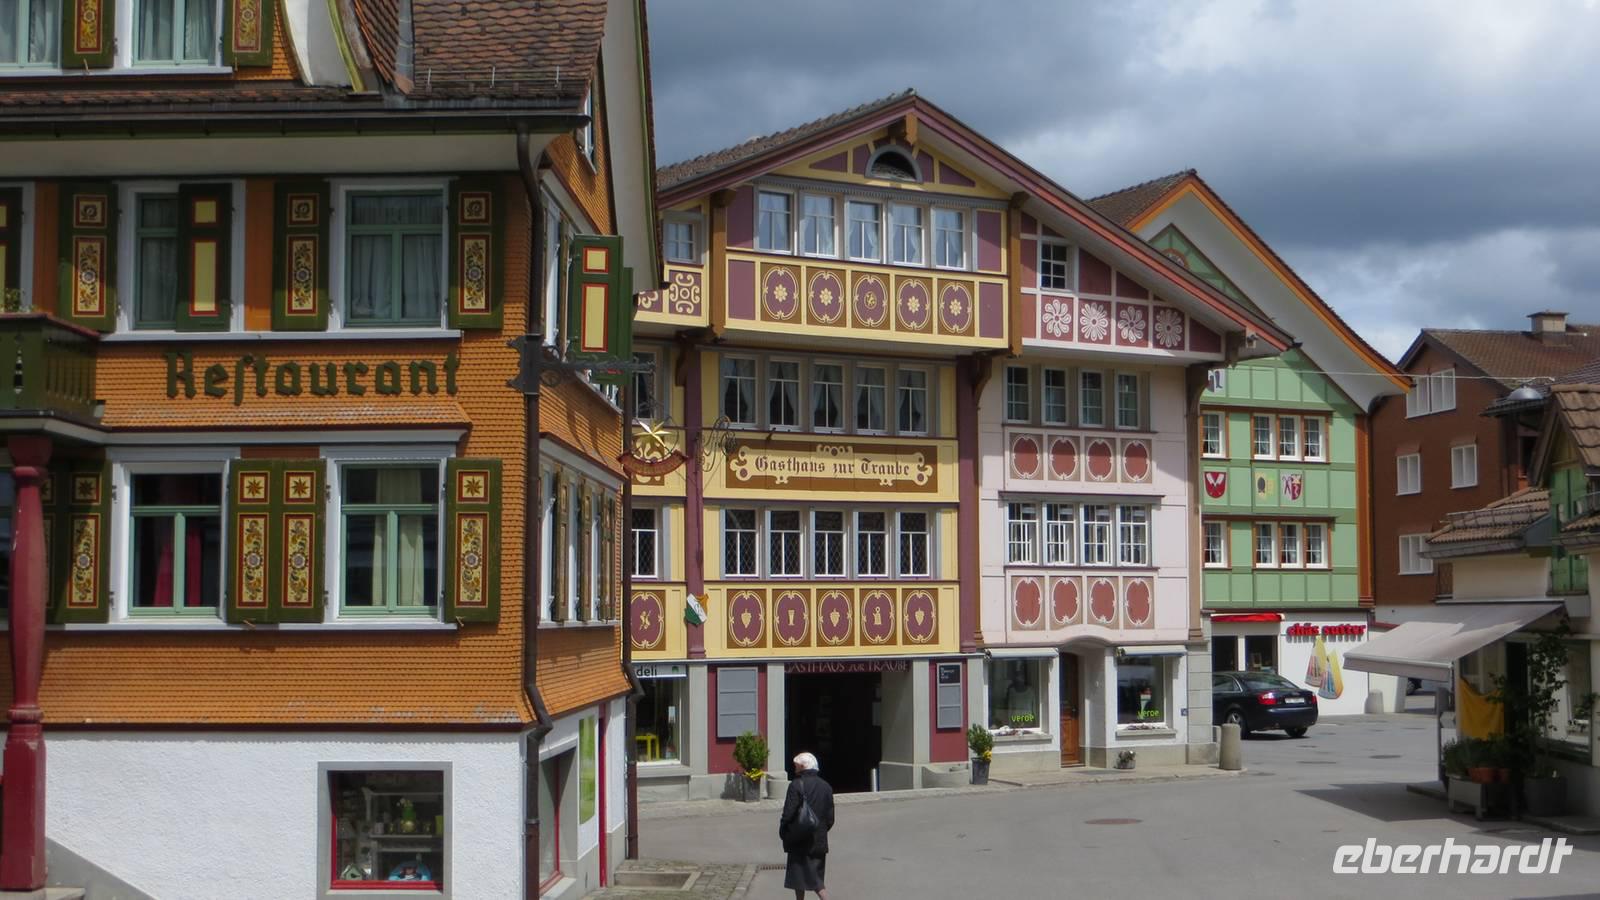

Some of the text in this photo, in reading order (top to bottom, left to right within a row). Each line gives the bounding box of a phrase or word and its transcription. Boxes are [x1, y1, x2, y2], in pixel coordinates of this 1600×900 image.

[755, 456, 910, 478] Gasthaus zur Traube
